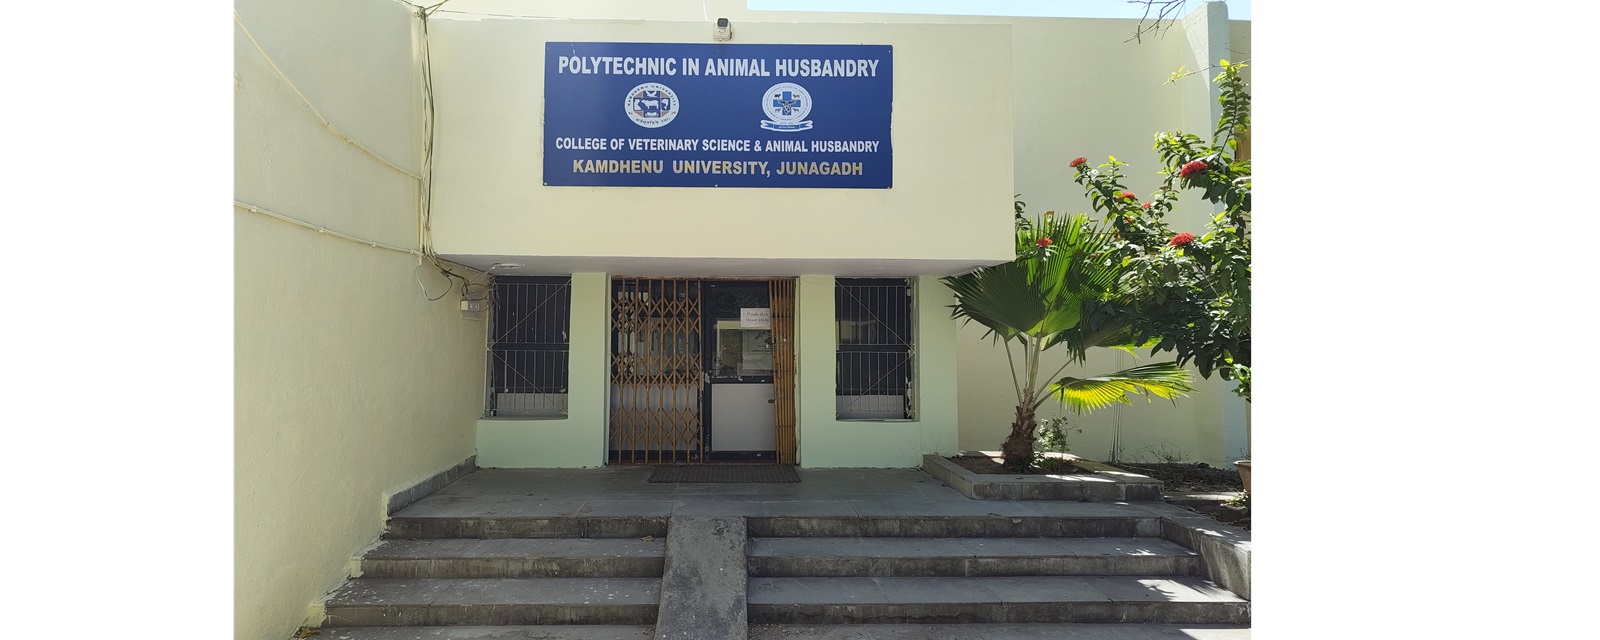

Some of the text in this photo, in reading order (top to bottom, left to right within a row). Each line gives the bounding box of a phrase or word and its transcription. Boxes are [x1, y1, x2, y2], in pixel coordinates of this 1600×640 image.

[558, 56, 880, 77] POLYTECHNIC IN ANIMAL HUSBANDRY
[555, 137, 880, 153] COLLEGE OF VETERINARY SCIENCE & ANIMAL HUSBANDRY
[572, 159, 863, 178] KAMDHENU UNIVERSITY, JUNAGADH
